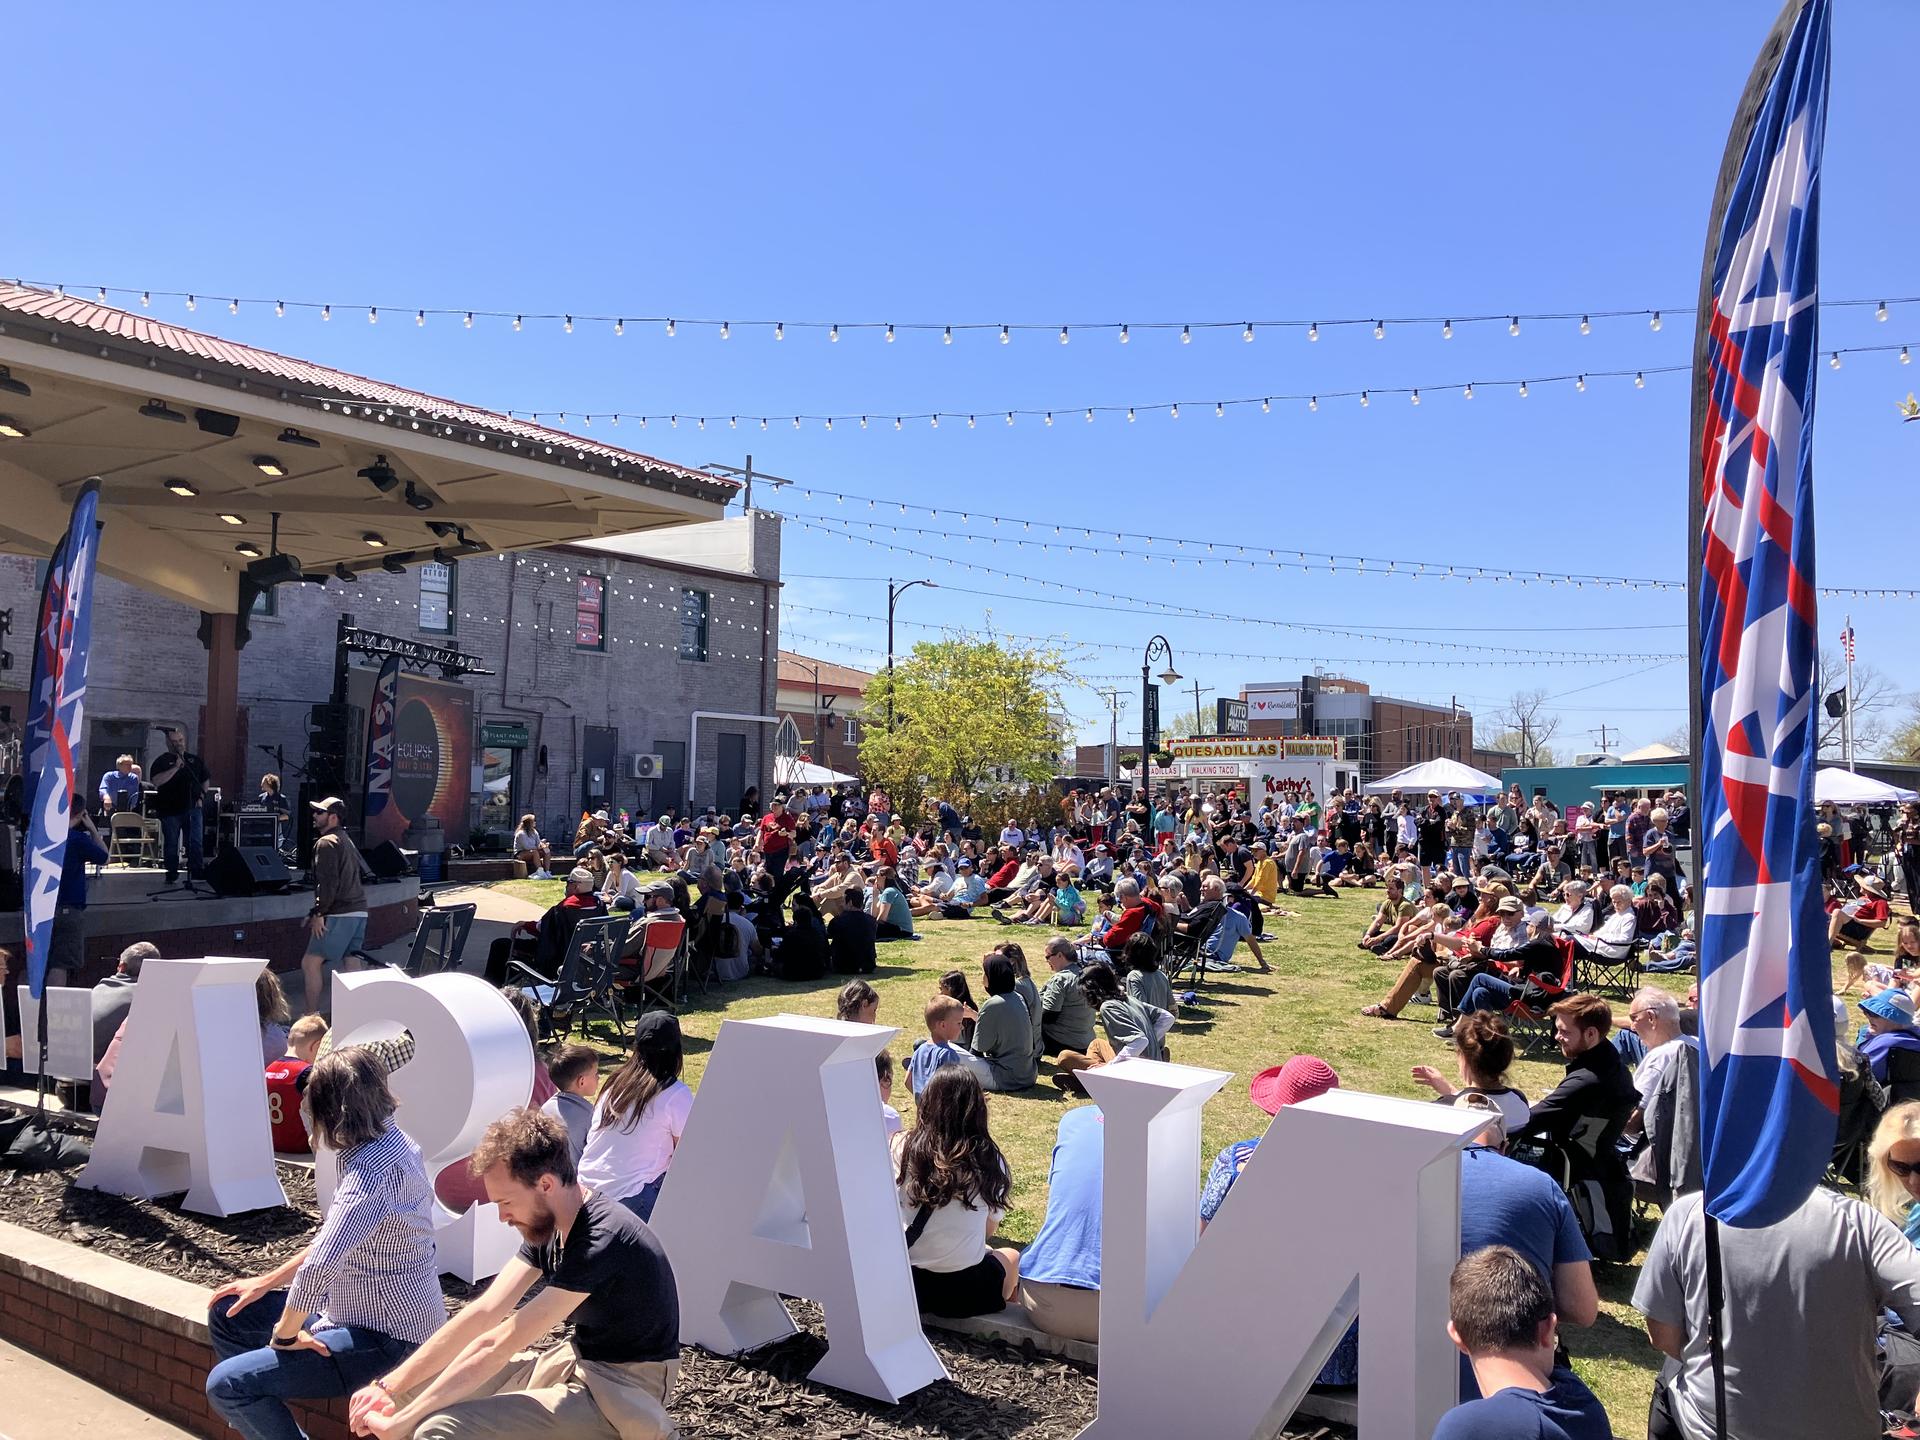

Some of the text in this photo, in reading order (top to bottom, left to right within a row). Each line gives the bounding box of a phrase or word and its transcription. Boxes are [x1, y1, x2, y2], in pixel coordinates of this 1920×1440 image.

[1229, 703, 1247, 719] AUTO
[369, 671, 396, 794] NASA
[1227, 718, 1247, 733] PARTS
[397, 743, 433, 760] ECLIPSE
[1174, 744, 1278, 758] QUESADILLAS
[1285, 742, 1333, 756] WALKING TACO
[1135, 767, 1177, 776] QUADILLAS
[1191, 766, 1235, 775] WALKING TACO
[1265, 776, 1311, 795] Kathy's
[268, 1092, 284, 1124] 8
